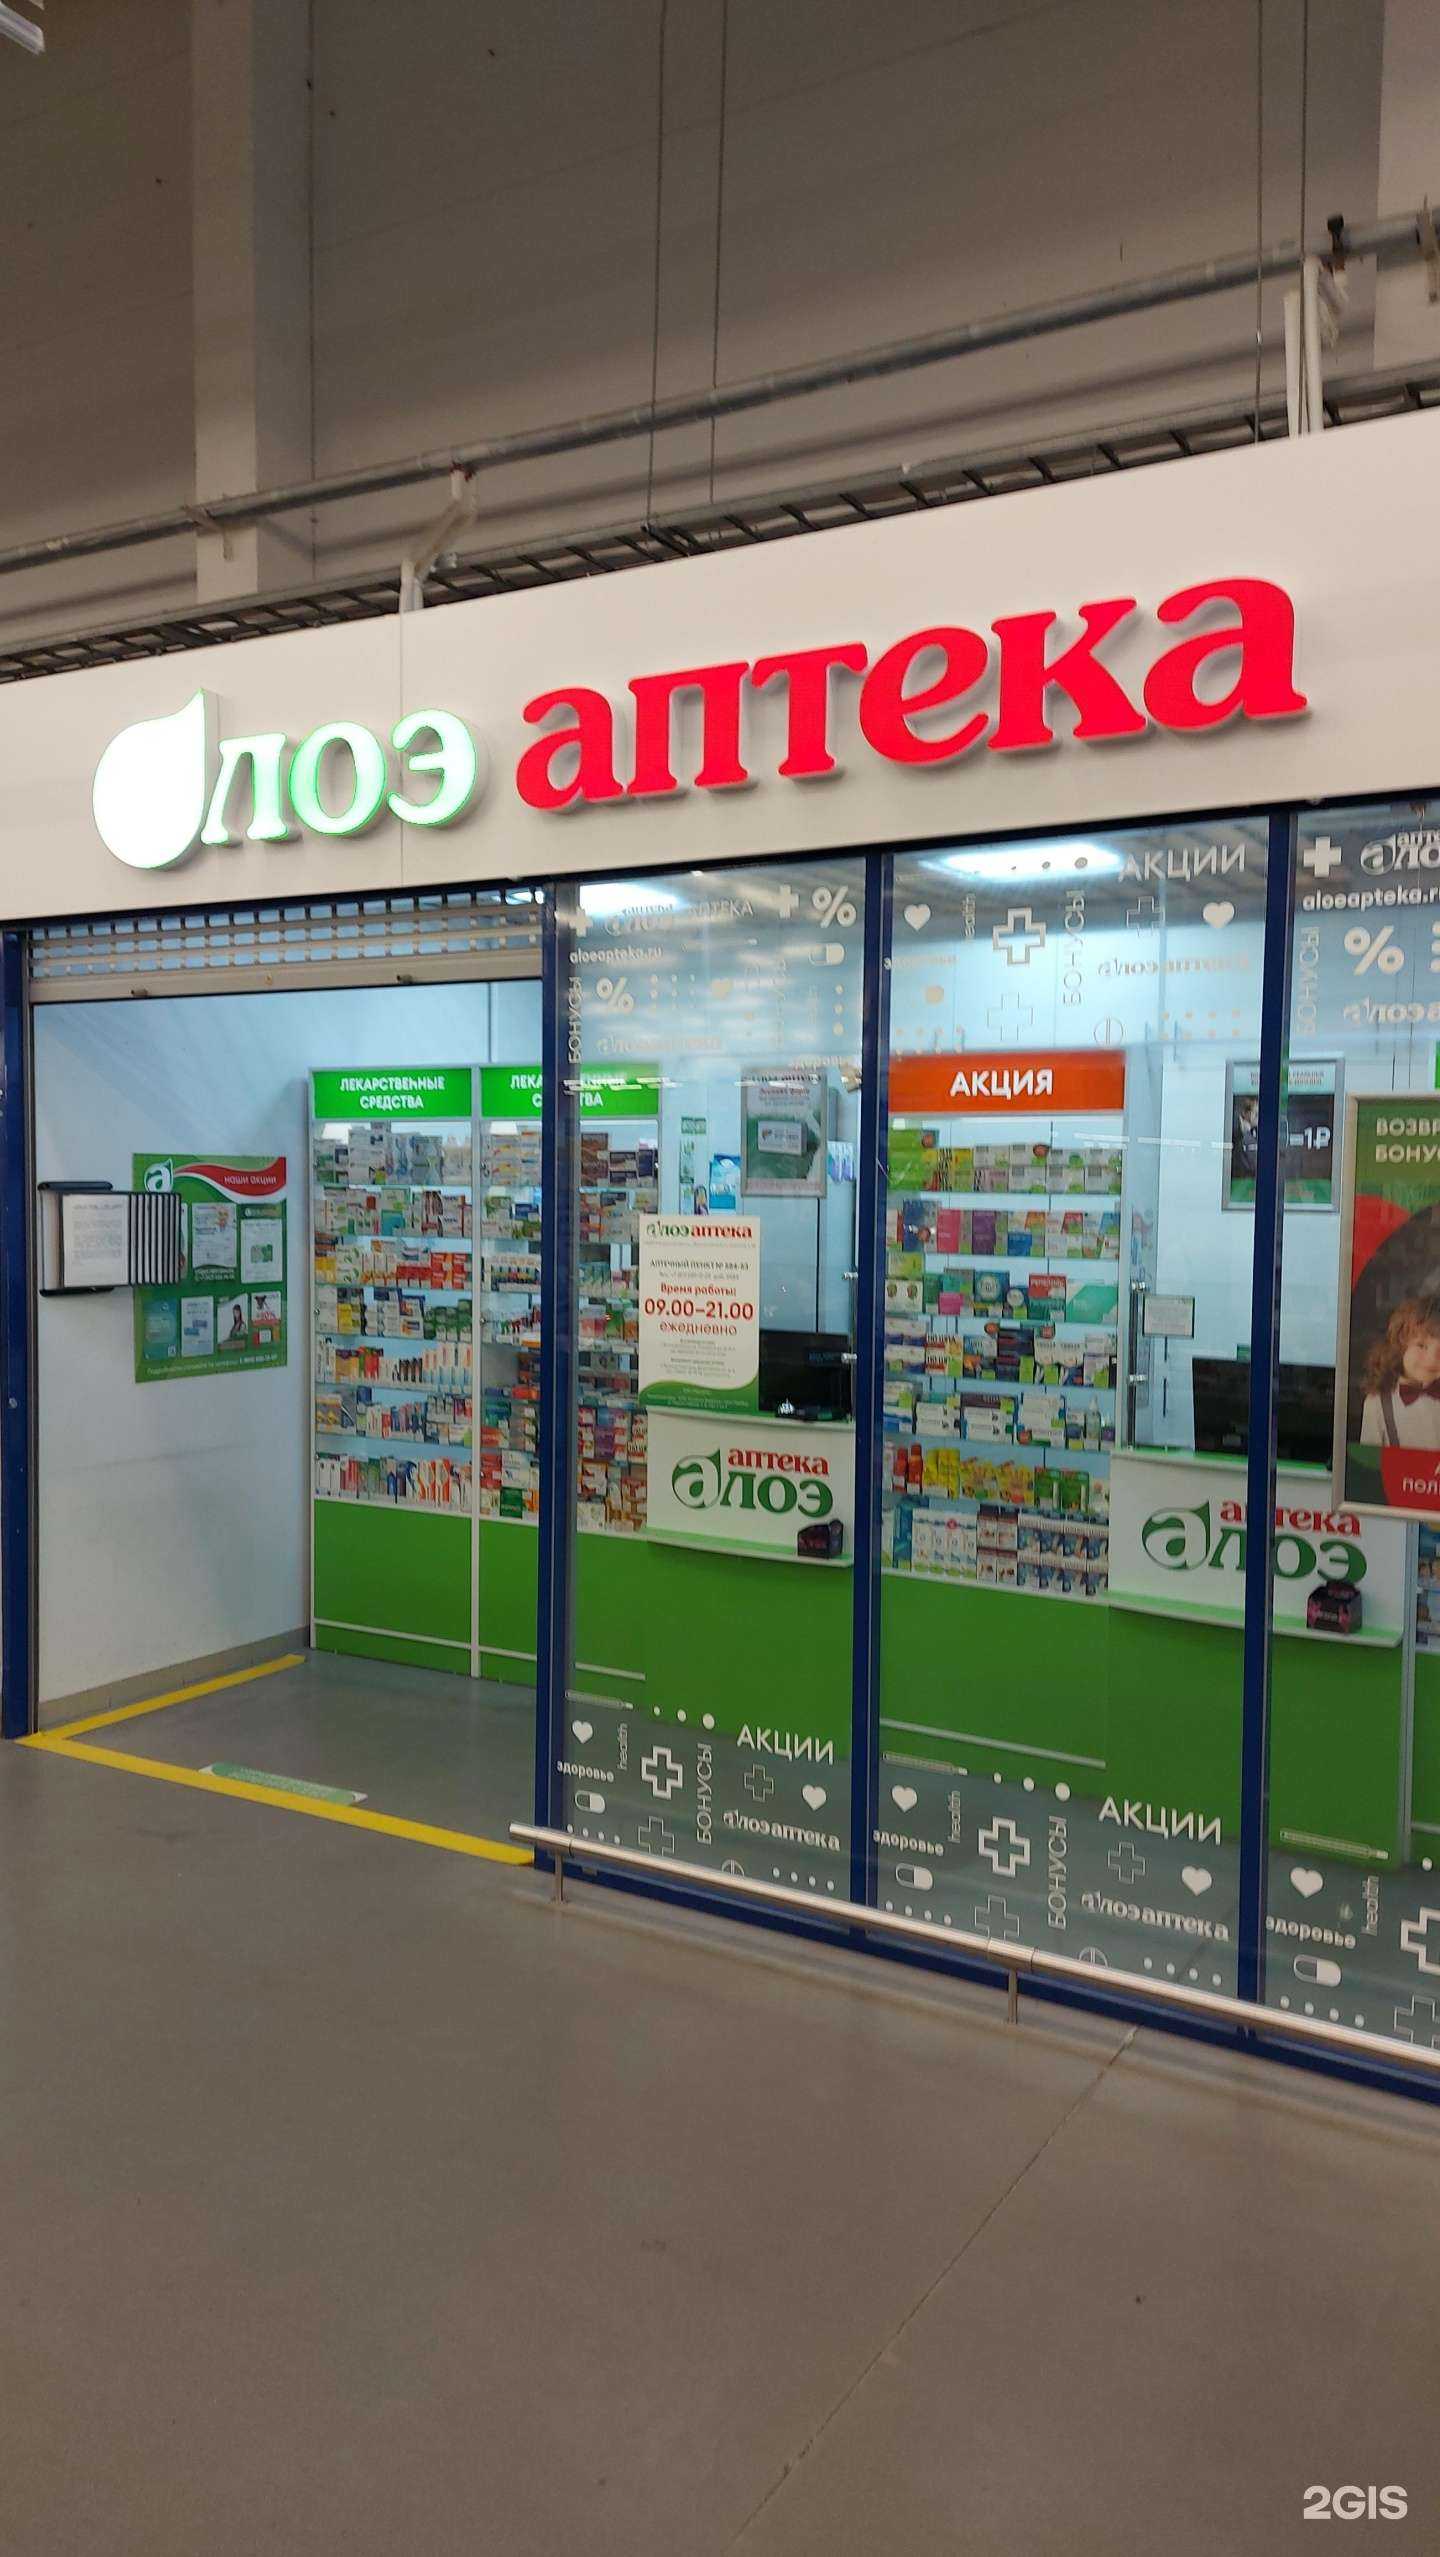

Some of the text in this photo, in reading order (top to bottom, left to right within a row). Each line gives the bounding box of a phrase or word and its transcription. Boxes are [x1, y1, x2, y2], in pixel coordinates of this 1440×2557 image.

[92, 576, 1307, 869] лоэ аптека
[1118, 843, 1246, 883] АКЦИИ
[1303, 884, 1440, 912] aloeapteka.r
[568, 977, 582, 1064] БОНУСЫ
[339, 1075, 446, 1092] ЛЕКАРСТВЕННЫЕ
[949, 1068, 1054, 1099] АКЦИЯ
[359, 1093, 424, 1110] СРЕДСТВА
[661, 1282, 692, 1295] Время
[659, 1321, 738, 1337] ежедневно
[728, 1448, 829, 1477] аптека
[1402, 1477, 1440, 1496] пол
[1220, 1499, 1361, 1537] атека
[736, 1723, 835, 1766] АКЦИИ
[556, 1760, 615, 1783] здоровье
[696, 1742, 713, 1846] БОНУСЫ
[1098, 1796, 1222, 1846] АКЦИИ
[873, 1829, 944, 1857] здоровье
[1047, 1815, 1067, 1931] БОНУСЫ
[1265, 1914, 1357, 1950] здоровье
